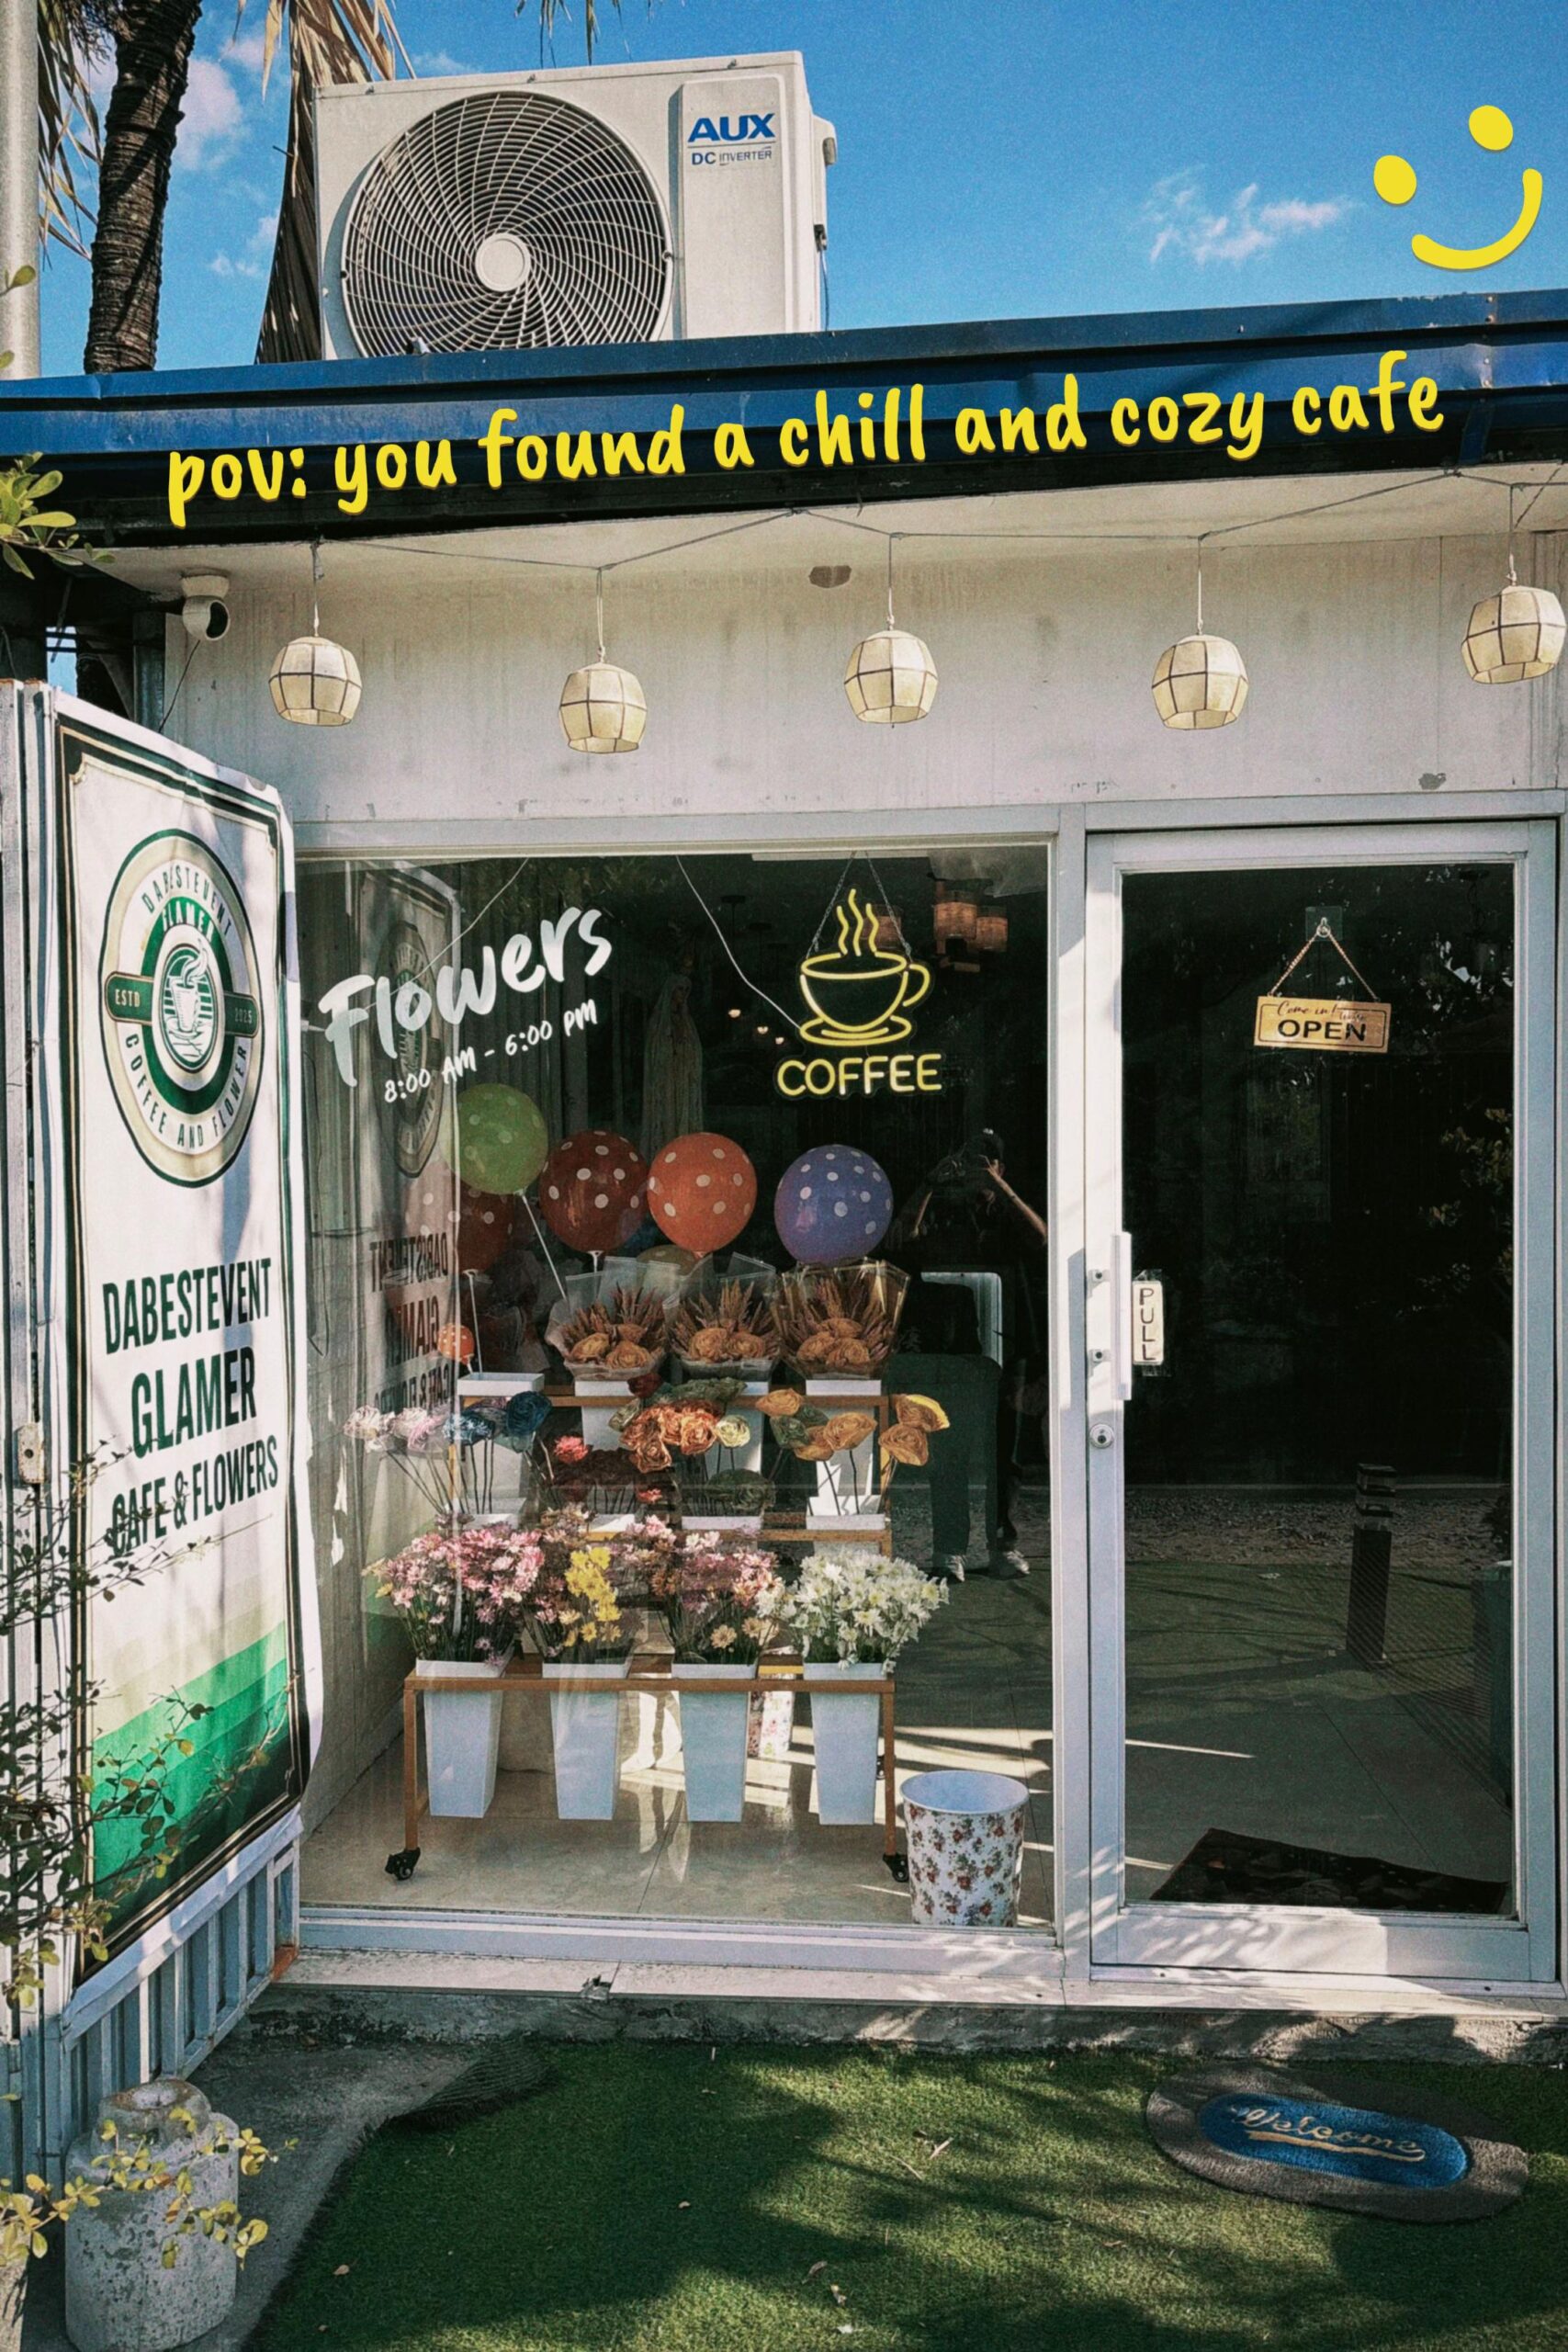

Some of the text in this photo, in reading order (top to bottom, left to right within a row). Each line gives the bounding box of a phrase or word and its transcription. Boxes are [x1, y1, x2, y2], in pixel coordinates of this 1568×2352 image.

[687, 113, 776, 142] AUX
[692, 152, 716, 165] DC
[318, 906, 613, 1088] Flowers
[1278, 1019, 1367, 1042] OPEN
[125, 1034, 247, 1148] COFFEE AND FLOWER
[384, 1068, 431, 1103] 8:00
[441, 1046, 477, 1084] AM
[505, 1020, 552, 1056] 6:00
[777, 1053, 942, 1096] COFFEE
[102, 1258, 272, 1355] DABESTEVENT
[1139, 1287, 1156, 1361] PULL
[130, 1346, 257, 1459] GLAMER
[111, 1434, 278, 1557] CAFE & FLOWERS
[1231, 2106, 1426, 2161] Welcome
